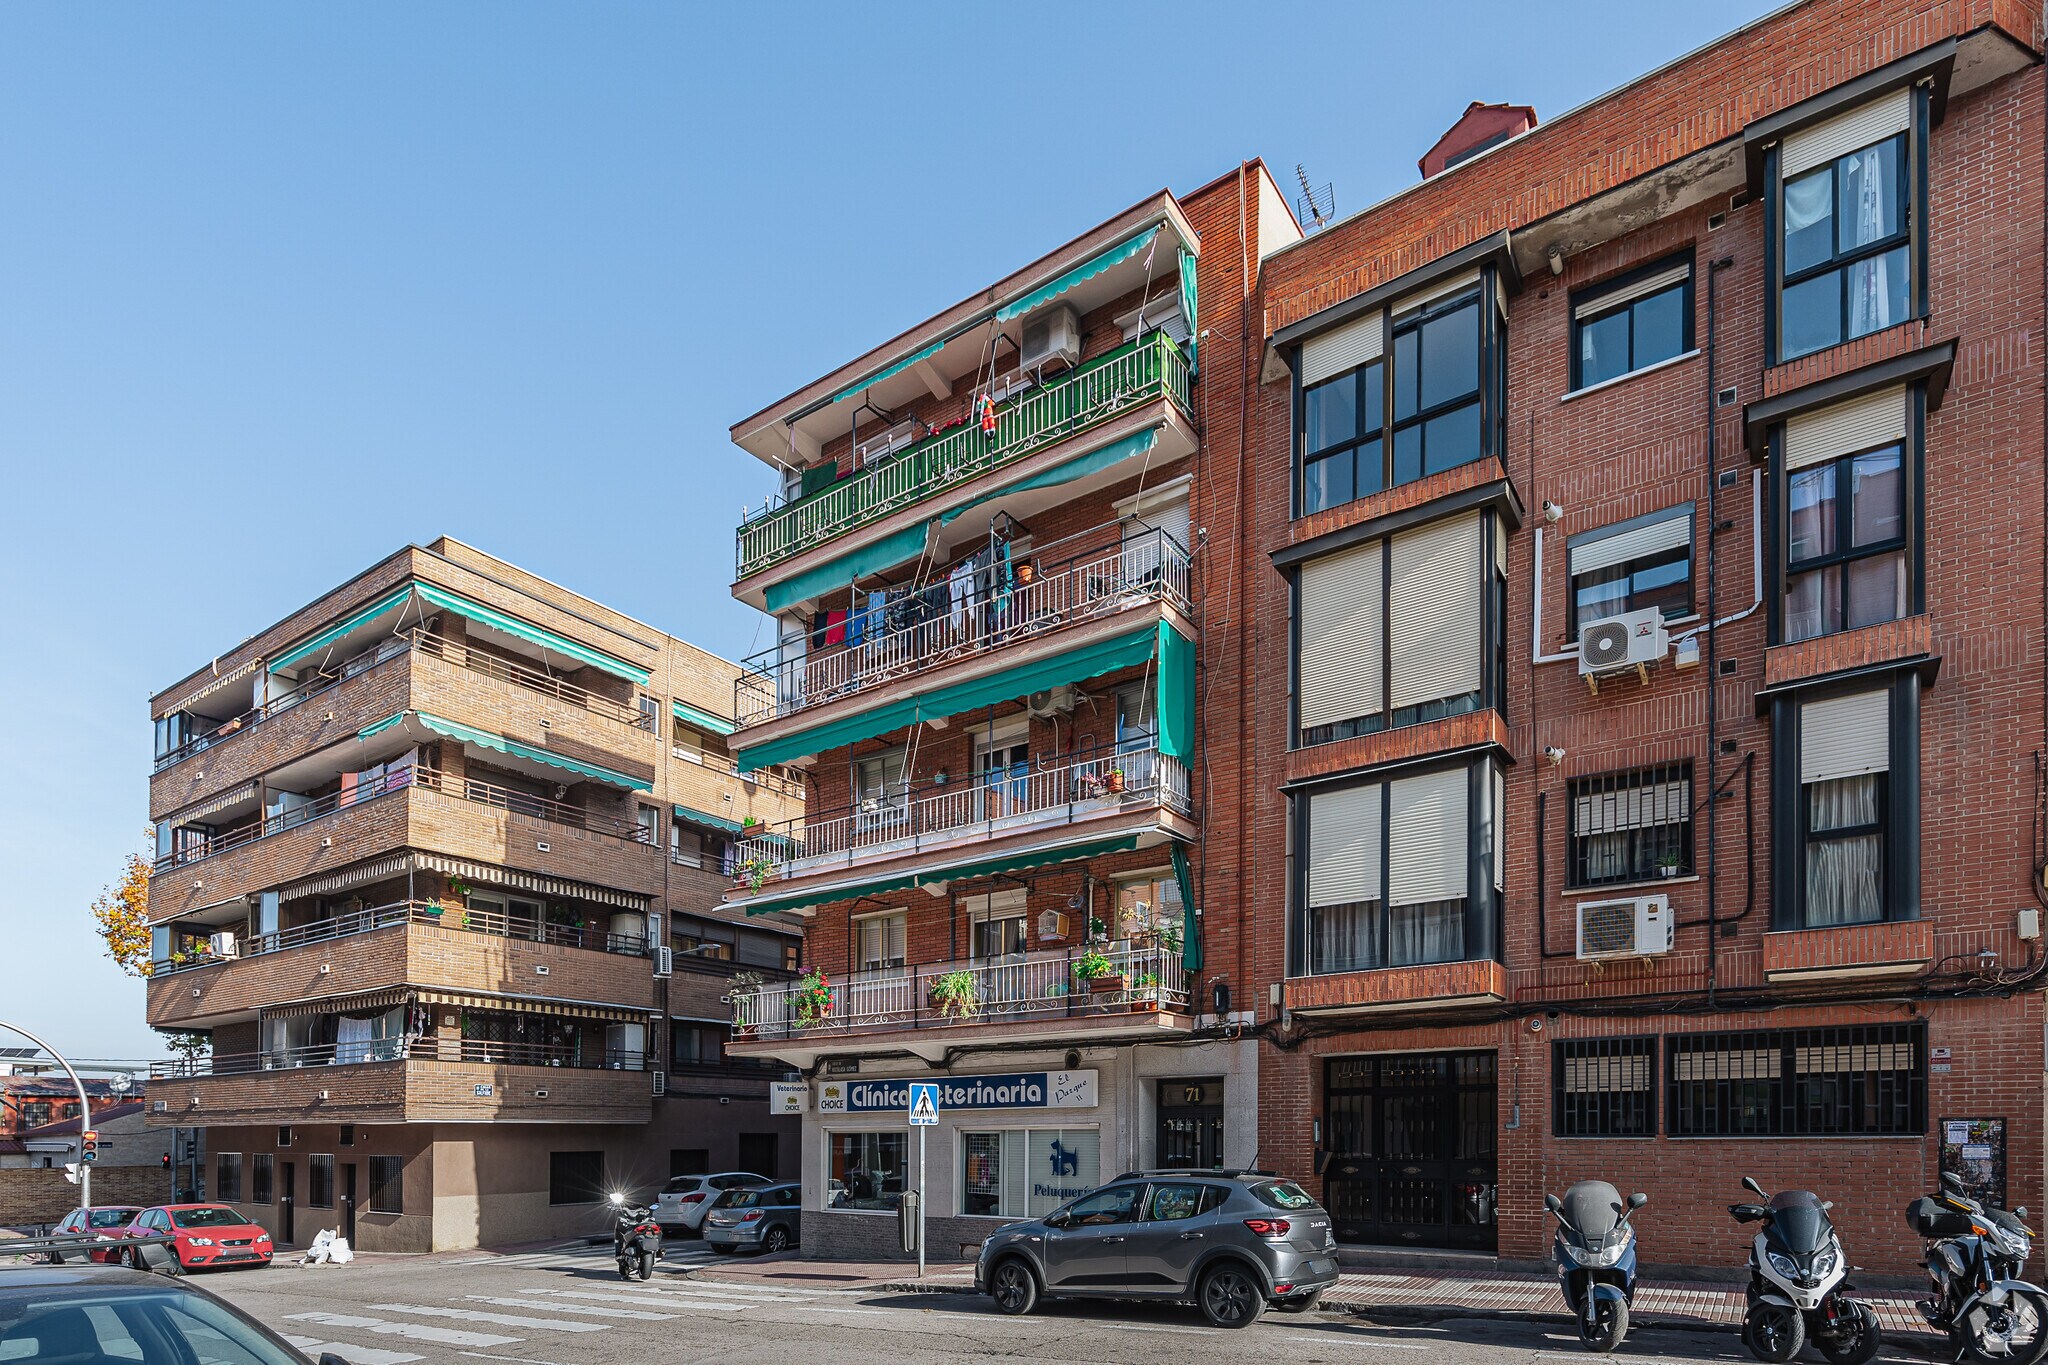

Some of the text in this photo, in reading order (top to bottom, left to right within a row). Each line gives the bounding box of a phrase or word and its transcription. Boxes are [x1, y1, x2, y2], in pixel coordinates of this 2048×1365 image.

[852, 1084, 909, 1107] Clínica
[1185, 1087, 1200, 1102] 71
[821, 1100, 844, 1109] CHOICE
[1034, 1184, 1092, 1200] Peluquerí
